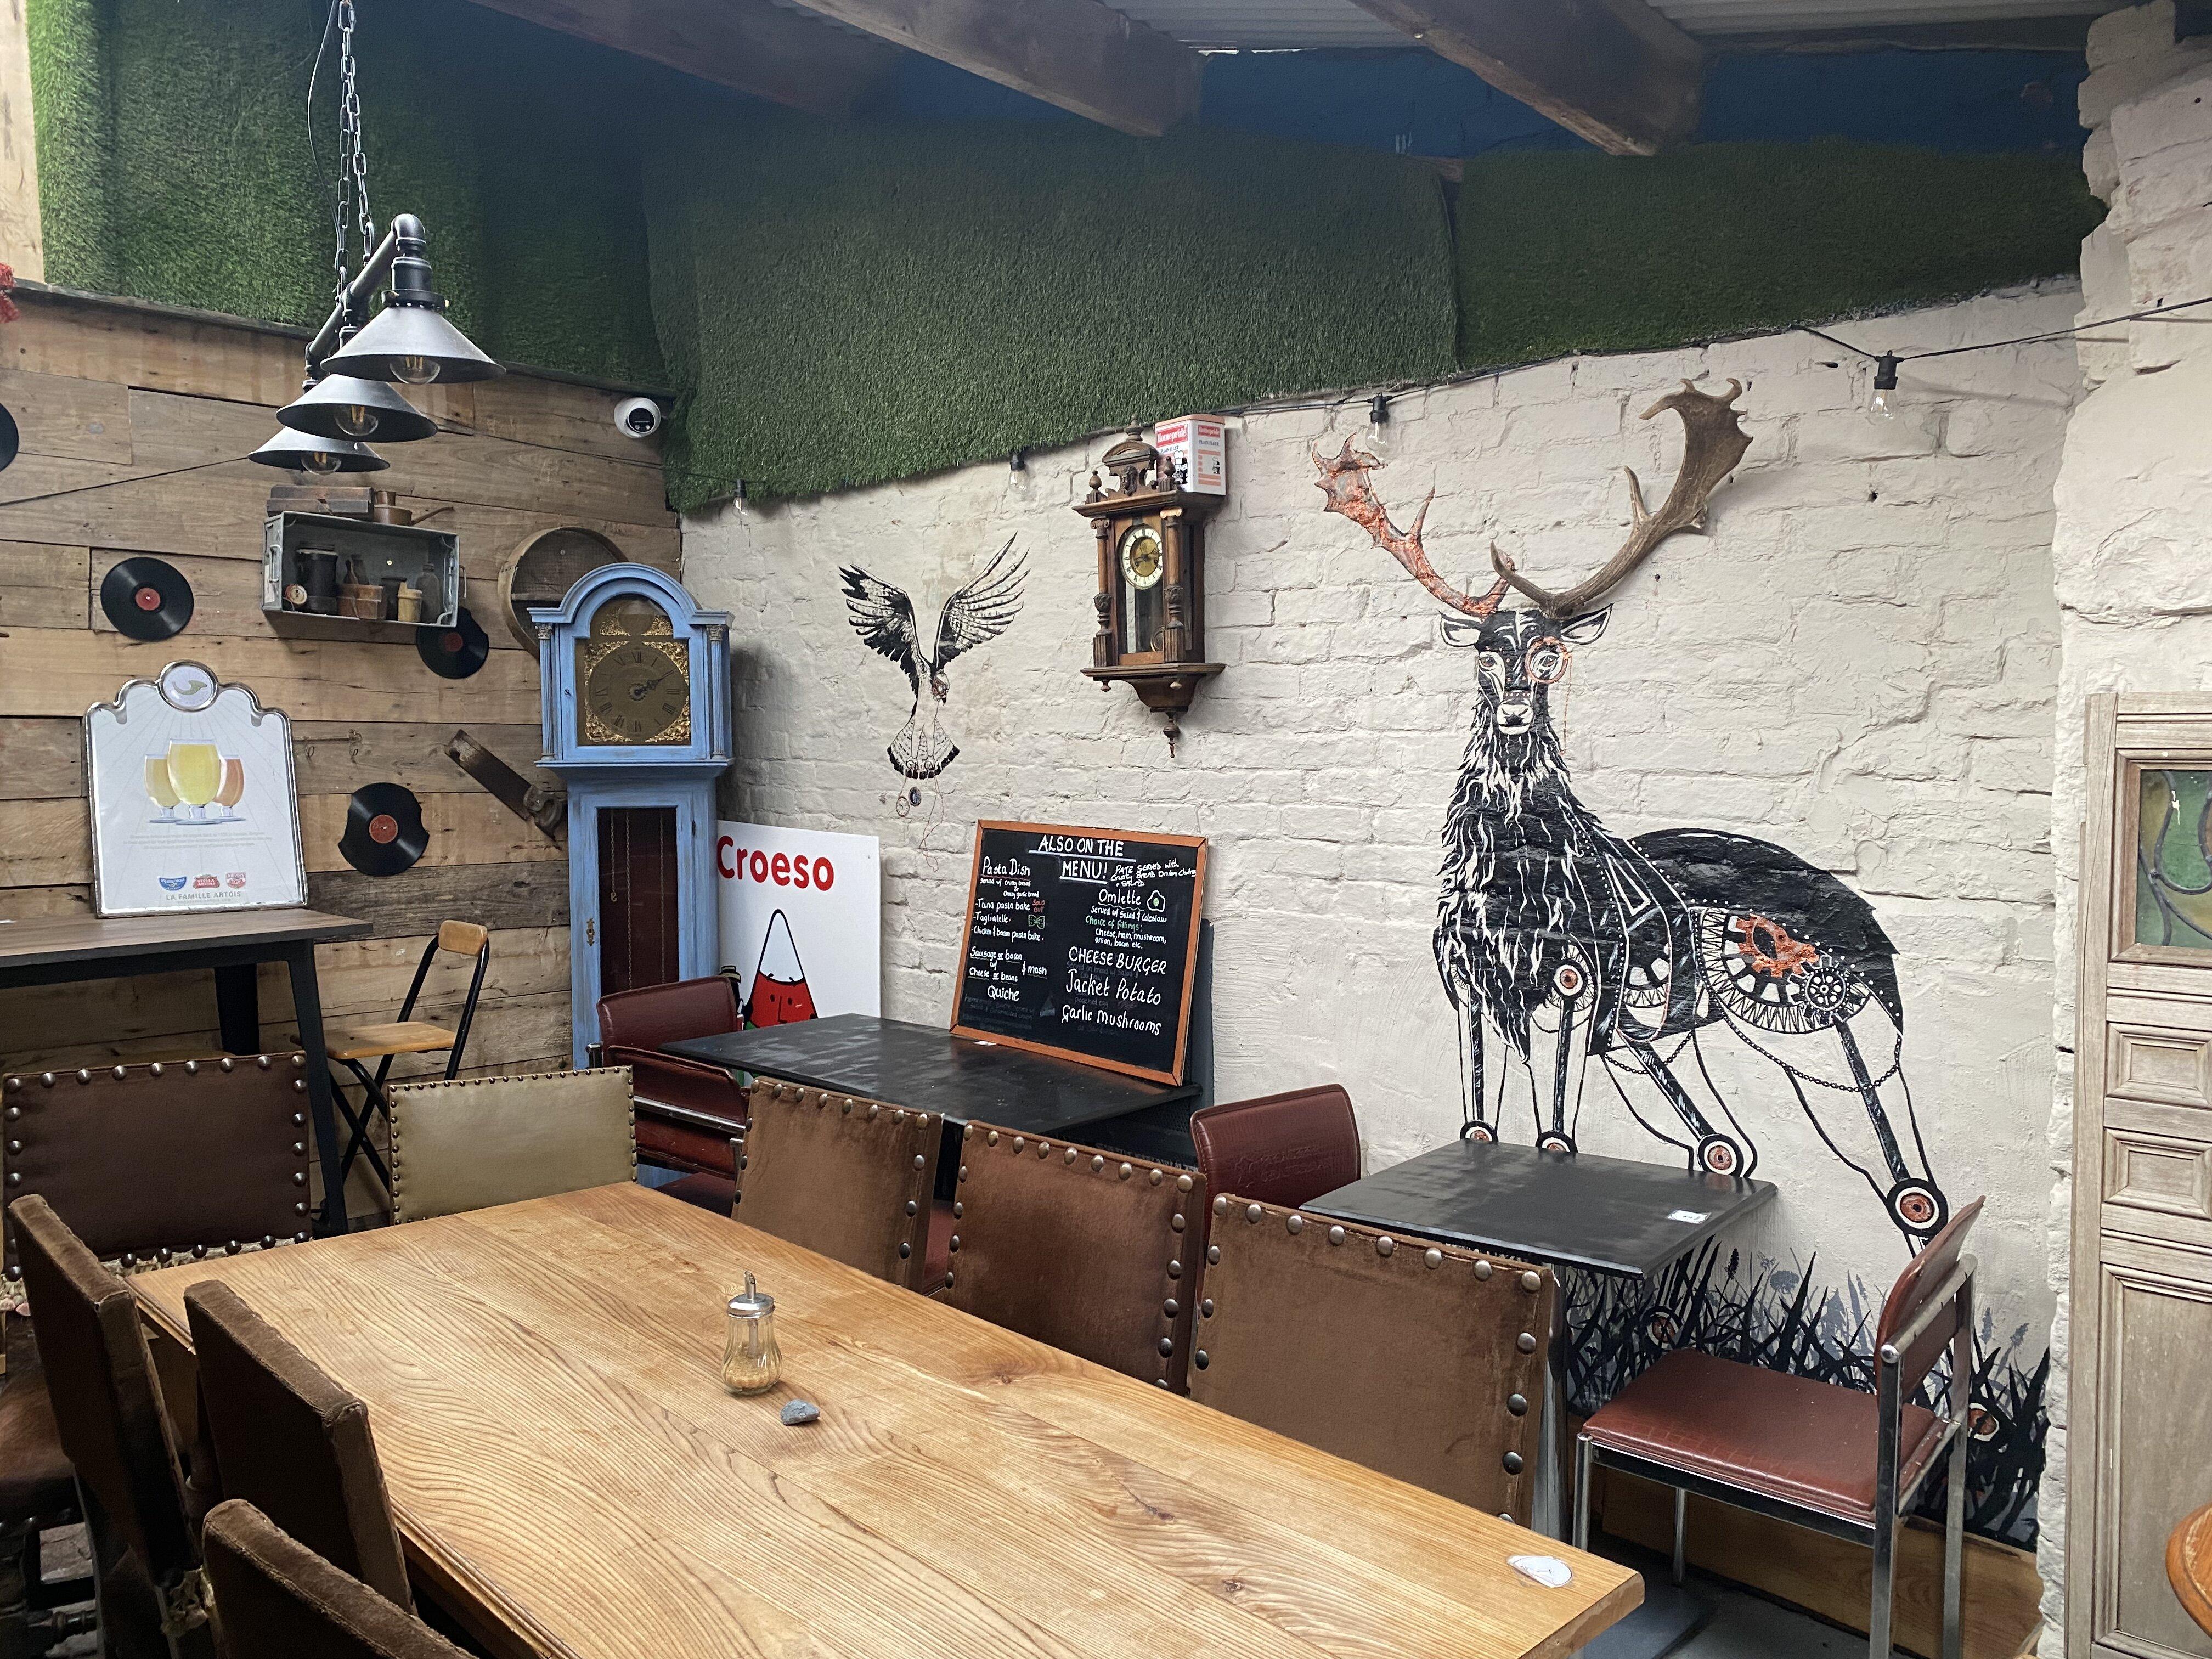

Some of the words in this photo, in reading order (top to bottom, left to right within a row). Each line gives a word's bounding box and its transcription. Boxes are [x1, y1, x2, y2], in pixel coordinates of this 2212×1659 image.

[1157, 427, 1187, 443] Homepride
[1038, 834, 1074, 853] ALSO
[1077, 838, 1093, 853] ON
[1097, 839, 1124, 857] THE
[716, 836, 834, 891] Croeso
[982, 856, 1007, 875] Pasta
[1009, 857, 1030, 877] Dish
[1062, 860, 1108, 879] MENU!
[1098, 888, 1142, 906] Omlette
[996, 901, 1014, 913] pasta
[1015, 901, 1031, 911] bake
[1090, 905, 1110, 915] Served
[1085, 915, 1106, 926] Choice
[1108, 919, 1115, 930] of
[996, 927, 1011, 937] bacon
[1012, 931, 1027, 943] pasta
[1114, 935, 1130, 947] bacon
[1117, 930, 1133, 941] ham,
[1133, 933, 1166, 944] mushroom,
[970, 946, 997, 961] Sausage
[1005, 949, 1023, 961] bacon
[1068, 946, 1114, 966] CHEESE
[1115, 952, 1167, 976] BURGER
[1001, 971, 1018, 983] beans
[1028, 965, 1047, 976] mash
[987, 985, 1019, 1002] Quiche
[1065, 968, 1110, 997] Jacket
[1115, 978, 1161, 1005] Potato
[1061, 1005, 1092, 1024] Garlic
